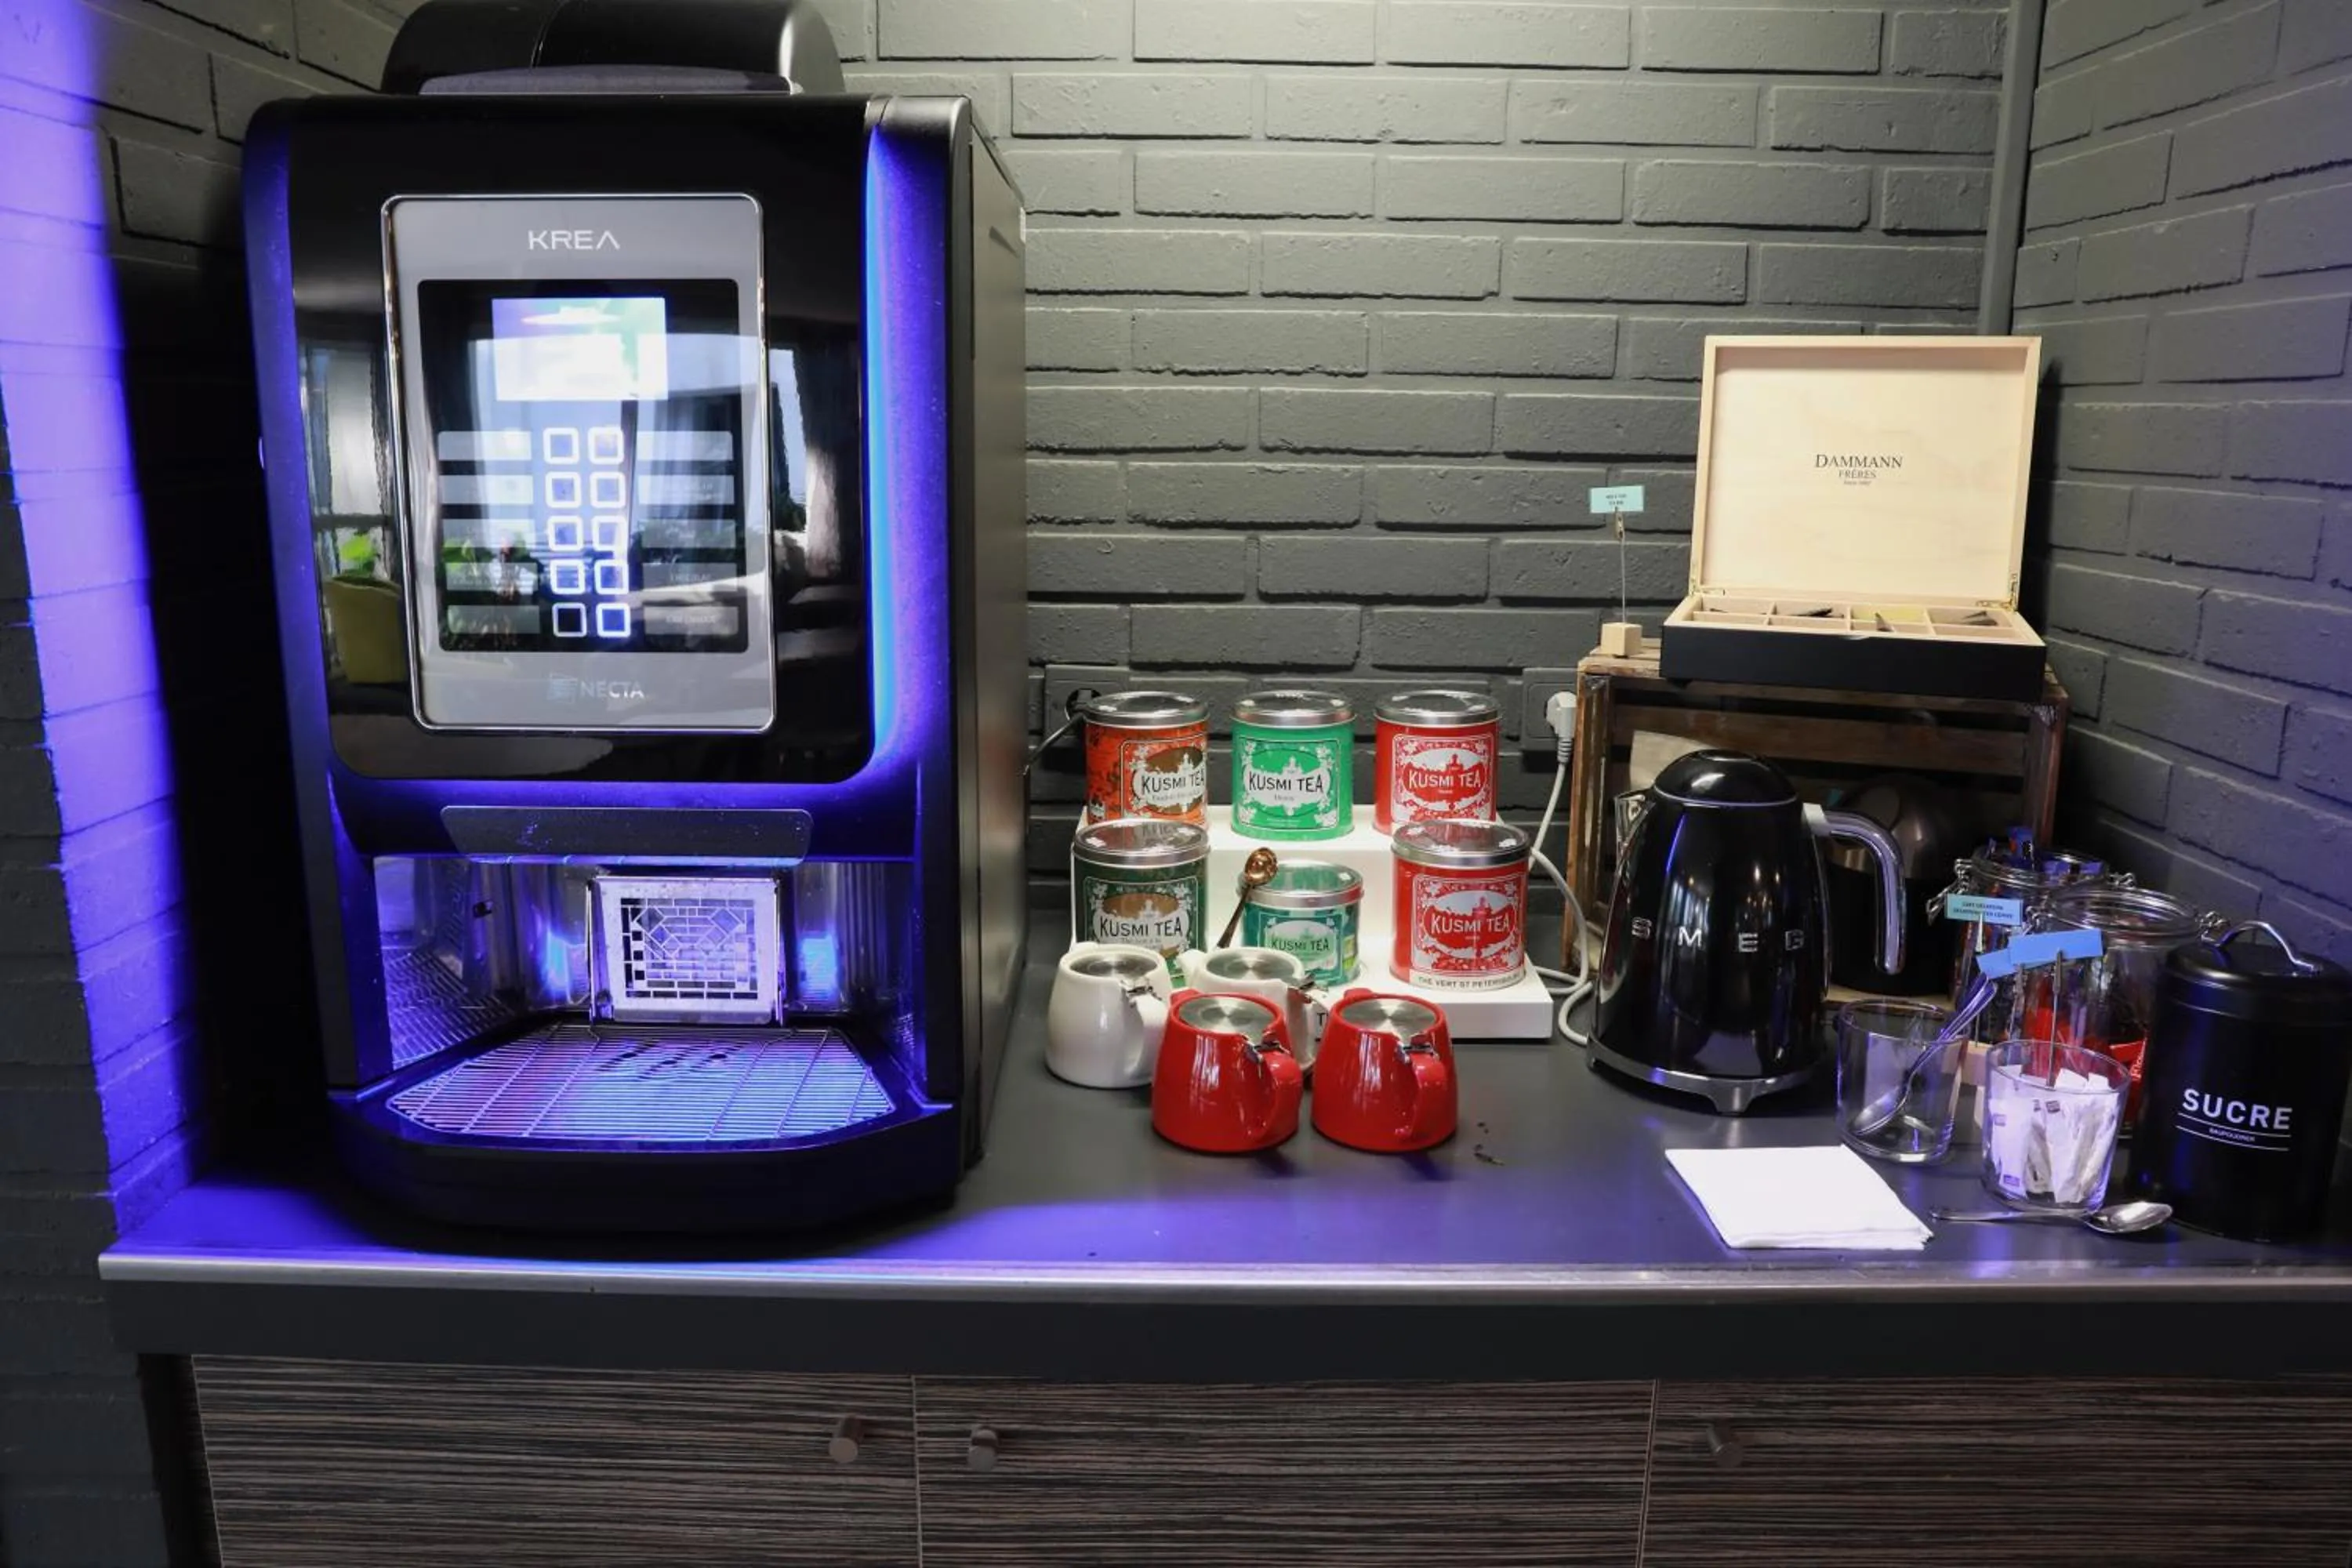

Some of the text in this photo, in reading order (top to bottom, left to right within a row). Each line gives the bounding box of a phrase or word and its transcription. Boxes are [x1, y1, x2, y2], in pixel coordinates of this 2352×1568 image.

[528, 230, 620, 250] KREA
[1815, 454, 1904, 468] DAMMANN
[580, 679, 644, 699] NECTA
[1142, 775, 1186, 795] KUSMI
[1249, 771, 1324, 793] KUSMI TEA
[1409, 770, 1481, 789] KUSMI TEA
[1100, 916, 1183, 938] KUSMI TEA
[1431, 912, 1510, 935] KUSMI TEA
[1271, 933, 1330, 952] KUSMI TEA
[1631, 916, 1804, 953] SMEG
[2182, 1087, 2293, 1131] SUCRE
